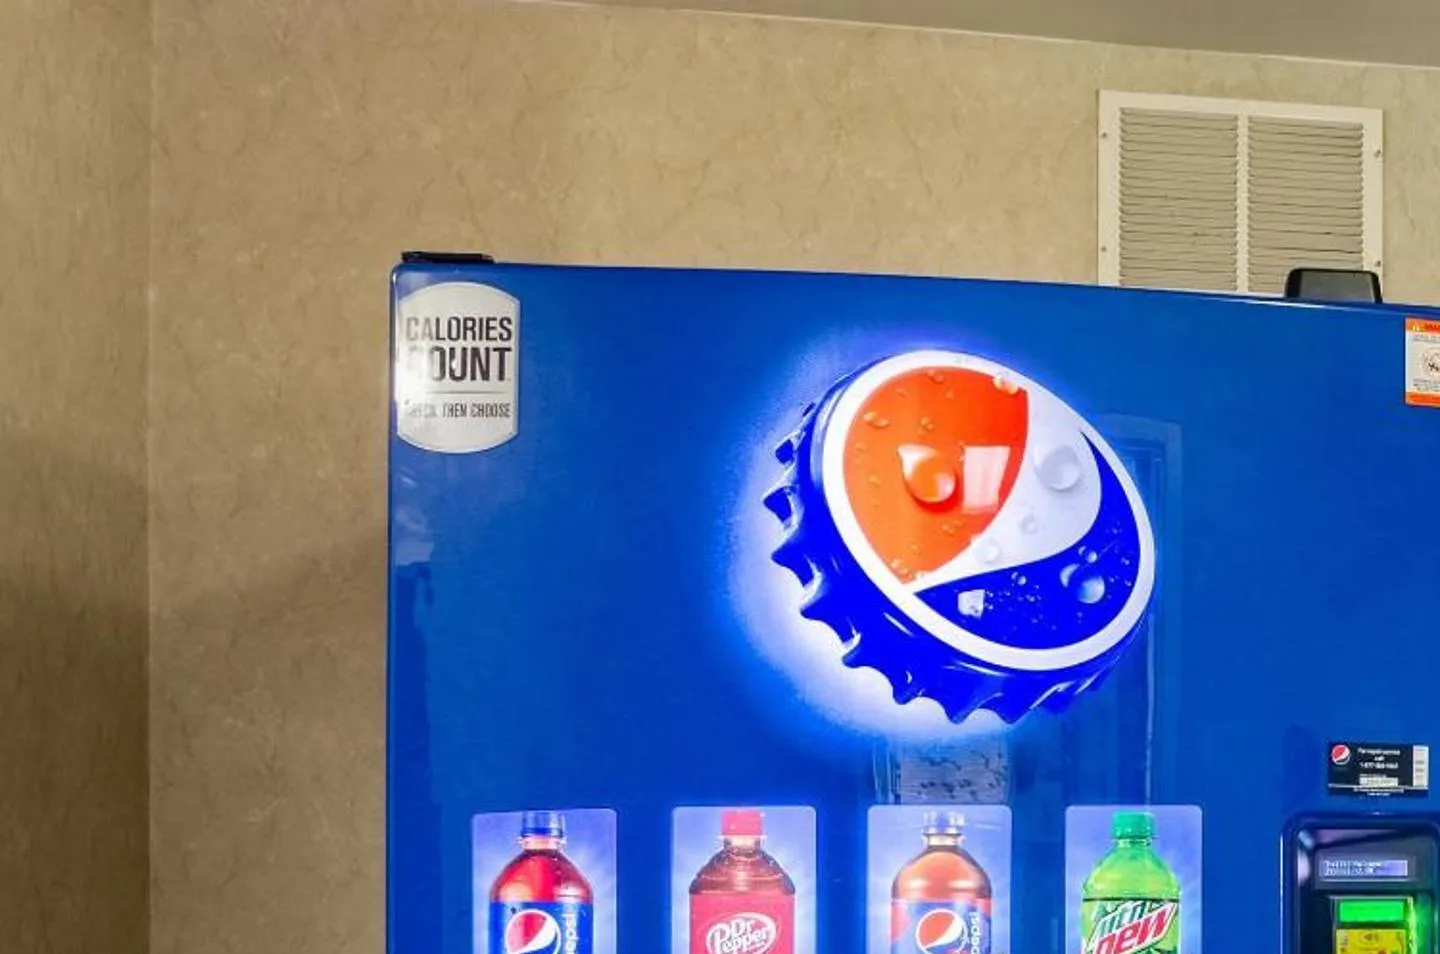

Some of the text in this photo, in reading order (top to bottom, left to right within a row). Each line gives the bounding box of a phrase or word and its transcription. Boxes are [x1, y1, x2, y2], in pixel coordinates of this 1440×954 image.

[407, 316, 512, 342] CALORIES
[471, 403, 511, 418] CHOOSE
[728, 914, 755, 939] Dr
